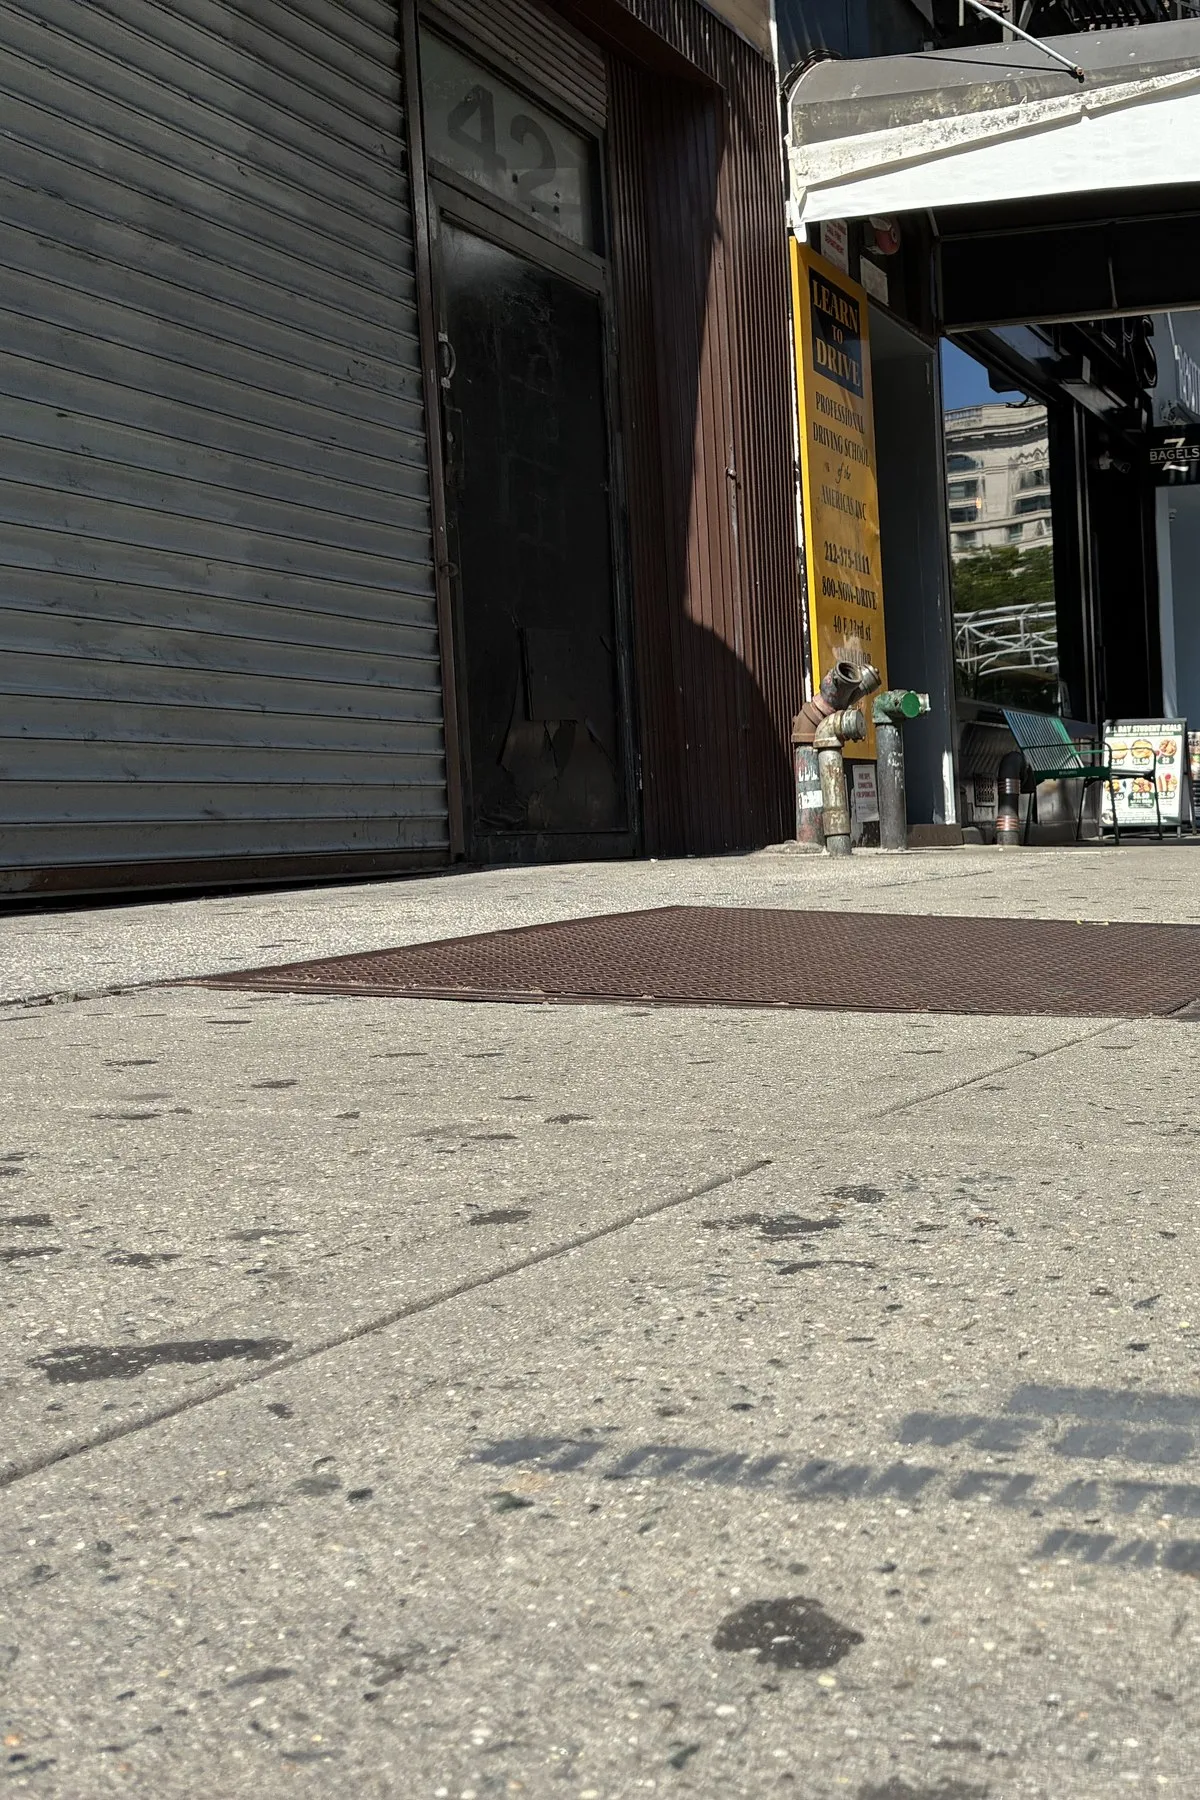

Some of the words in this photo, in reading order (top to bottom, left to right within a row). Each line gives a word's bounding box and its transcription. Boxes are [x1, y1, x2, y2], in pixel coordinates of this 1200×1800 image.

[447, 84, 561, 225] 42
[812, 279, 858, 333] LEARN
[832, 325, 843, 345] TO
[815, 336, 861, 387] DRIVE
[815, 391, 865, 434] PROFESSIONAL
[813, 424, 844, 455] DRIVING
[843, 436, 870, 468] SCHOOL
[1149, 448, 1200, 462] BAGELS
[603, 1446, 944, 1502] ITALIAN
